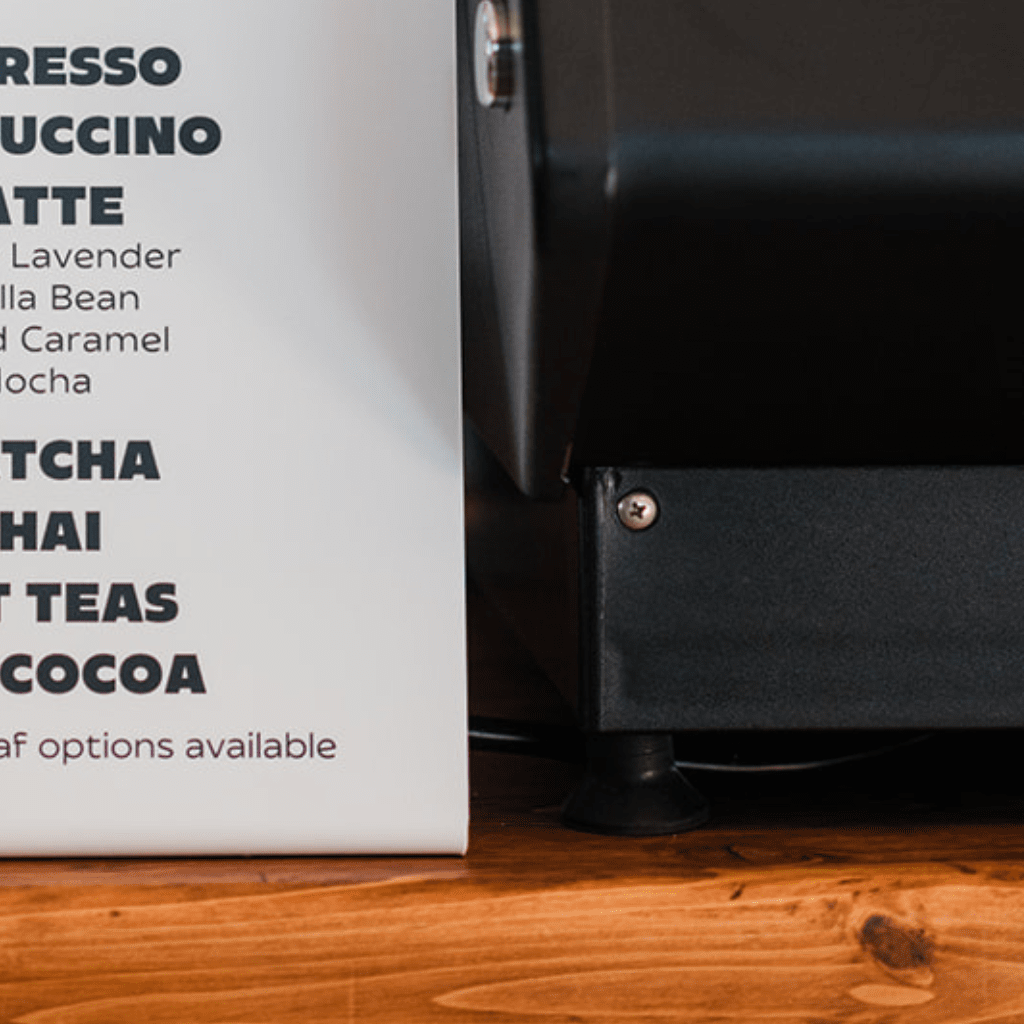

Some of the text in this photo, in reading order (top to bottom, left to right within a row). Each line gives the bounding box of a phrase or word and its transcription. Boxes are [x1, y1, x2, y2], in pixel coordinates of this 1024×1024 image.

[12, 242, 182, 270] Lavender
[51, 283, 140, 311] Bean
[21, 325, 169, 353] Caramel
[25, 582, 179, 624] TEAS
[38, 731, 175, 765] options
[185, 731, 337, 760] available
